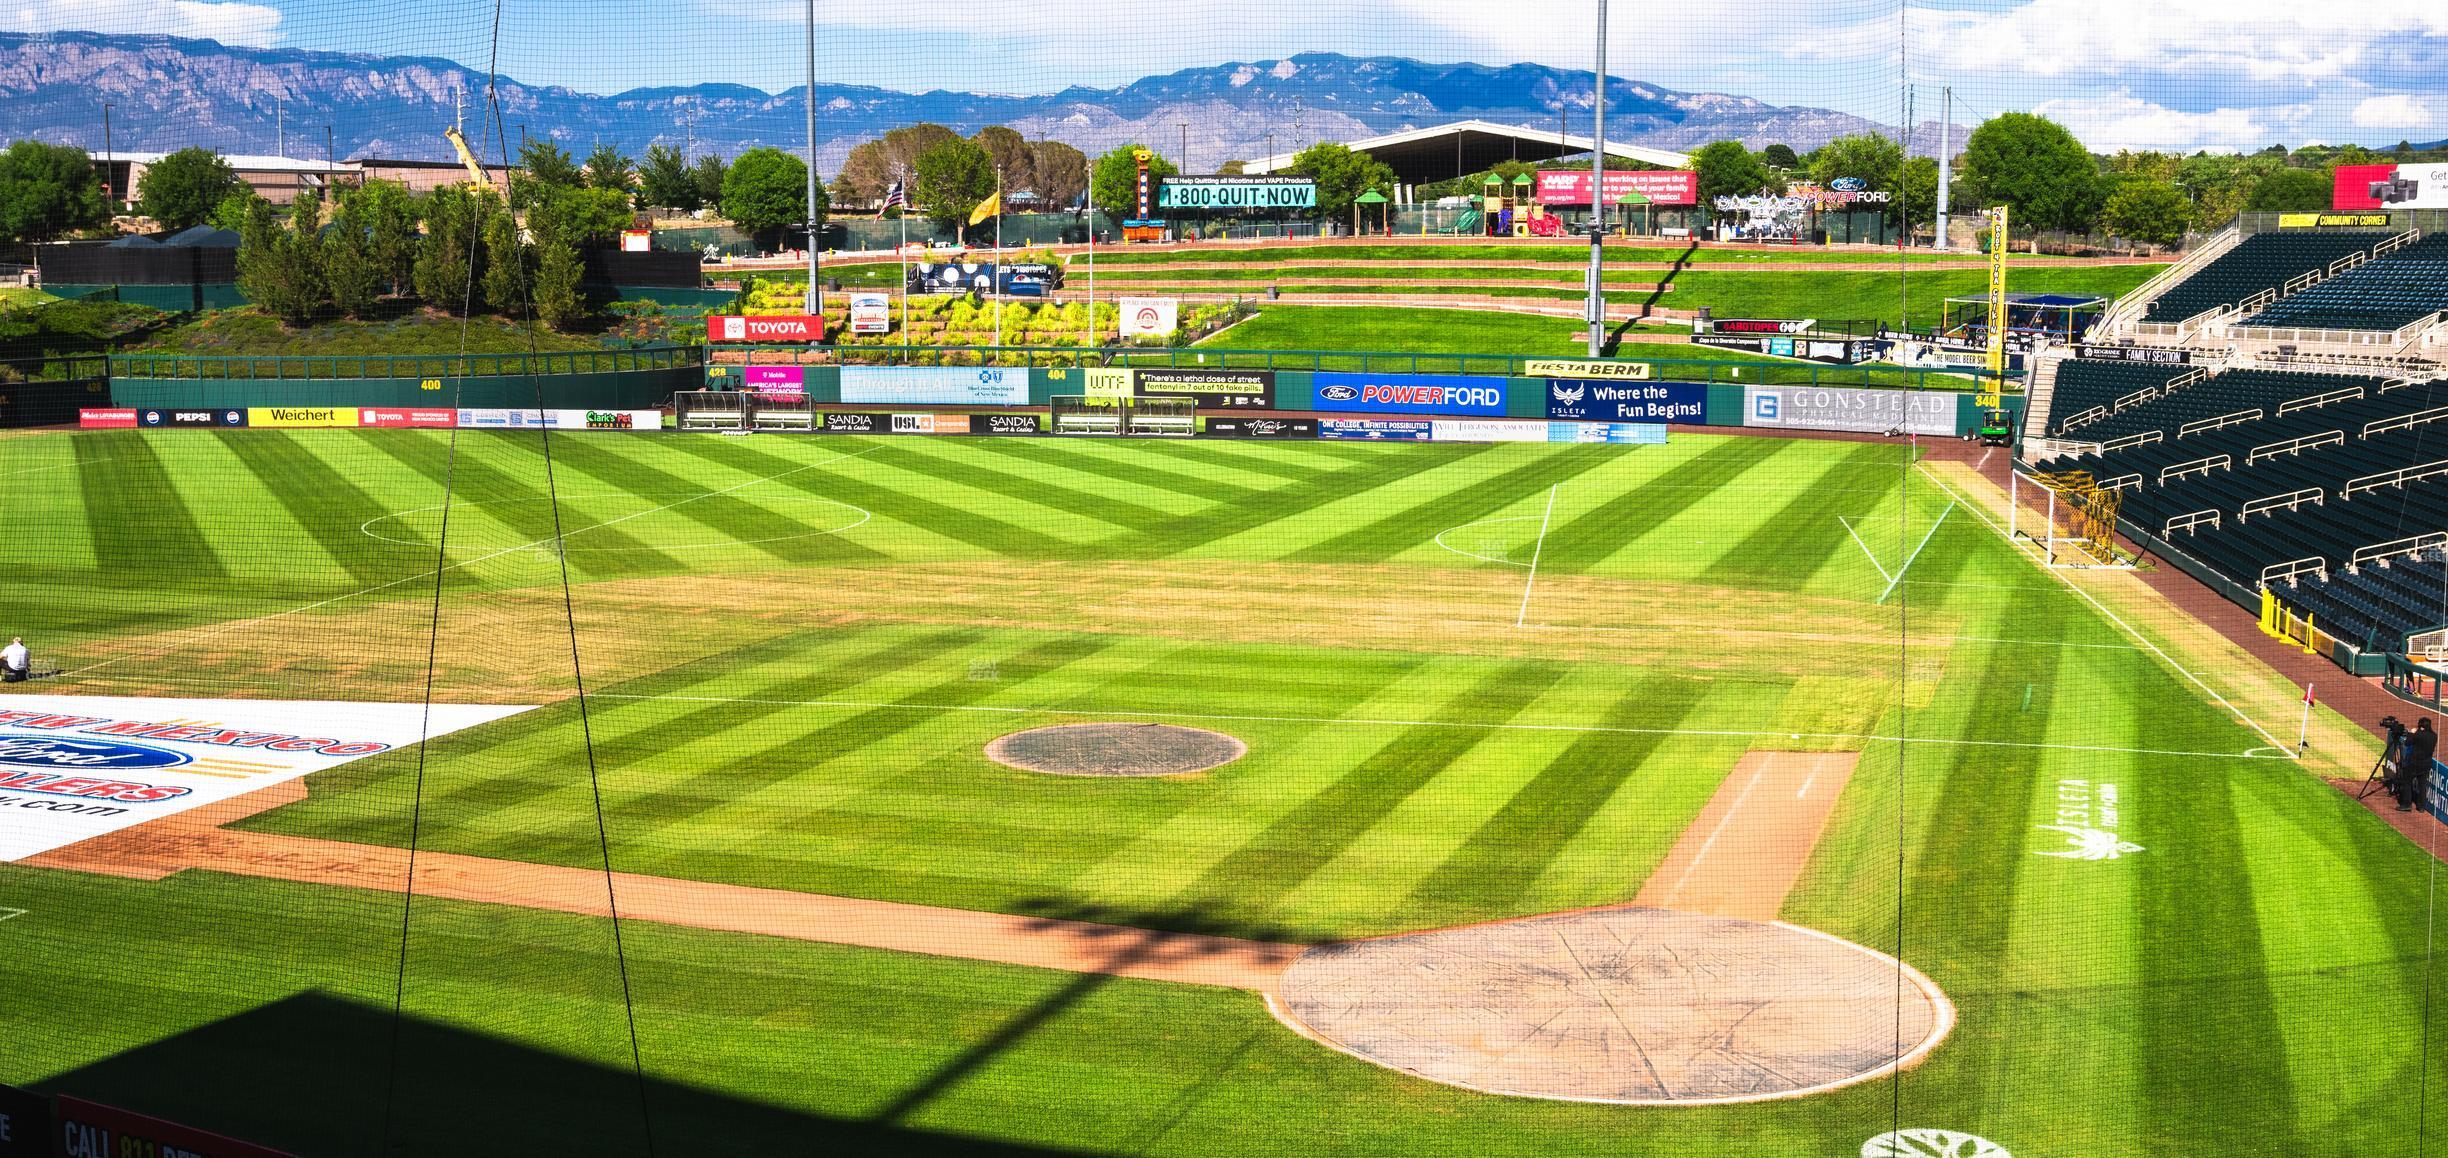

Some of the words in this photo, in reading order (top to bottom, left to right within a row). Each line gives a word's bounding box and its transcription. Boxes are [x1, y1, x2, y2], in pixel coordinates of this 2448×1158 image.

[1543, 175, 1579, 185] AARP
[1608, 175, 1637, 184] working
[1649, 175, 1666, 183] issues
[2431, 171, 2446, 180] Get
[1648, 185, 1664, 193] your
[1665, 184, 1688, 193] family
[1653, 191, 1680, 201] Mexico!
[2320, 215, 2360, 226] COMMUNITY
[2360, 215, 2386, 226] CORNER
[748, 322, 807, 334] TOYOTA
[1934, 354, 1944, 362] THE
[1945, 354, 1961, 363] MODEL
[1963, 354, 1976, 363] BEER
[2126, 349, 2151, 361] FAMILY
[2152, 351, 2181, 362] SECTION
[708, 368, 726, 377] 428
[1531, 362, 1586, 372] FIESTA
[1588, 365, 1643, 375] BERM
[1048, 370, 1066, 380] 404
[1146, 374, 1174, 382] There's
[421, 380, 441, 390] 400
[1090, 375, 1125, 389] WTF
[1147, 383, 1178, 391] fentanyl
[1326, 386, 1352, 400] Ford
[1362, 385, 1500, 407] POWERFORD
[1593, 387, 1640, 401] Where
[1643, 386, 1668, 399] the
[1794, 391, 1945, 413] GONSTEAD
[1975, 395, 1997, 408] 340
[271, 409, 335, 421] Weichert
[1618, 403, 1643, 418] Fun
[1648, 402, 1701, 419] Begins!
[175, 413, 211, 421] PEPSI
[377, 413, 404, 421] TOYOTA
[586, 411, 616, 422] Clark's
[617, 413, 632, 423] Pet
[828, 415, 872, 425] SANDIA
[989, 416, 1036, 426] SANDIA
[1802, 409, 1864, 418] PHYSICAL
[1873, 412, 1935, 423] MEDICINE
[1335, 421, 1362, 429] COLLEGE,
[1363, 421, 1387, 429] INFINITE
[80, 720, 392, 757] MEXICO
[64, 1120, 109, 1158] CALL
